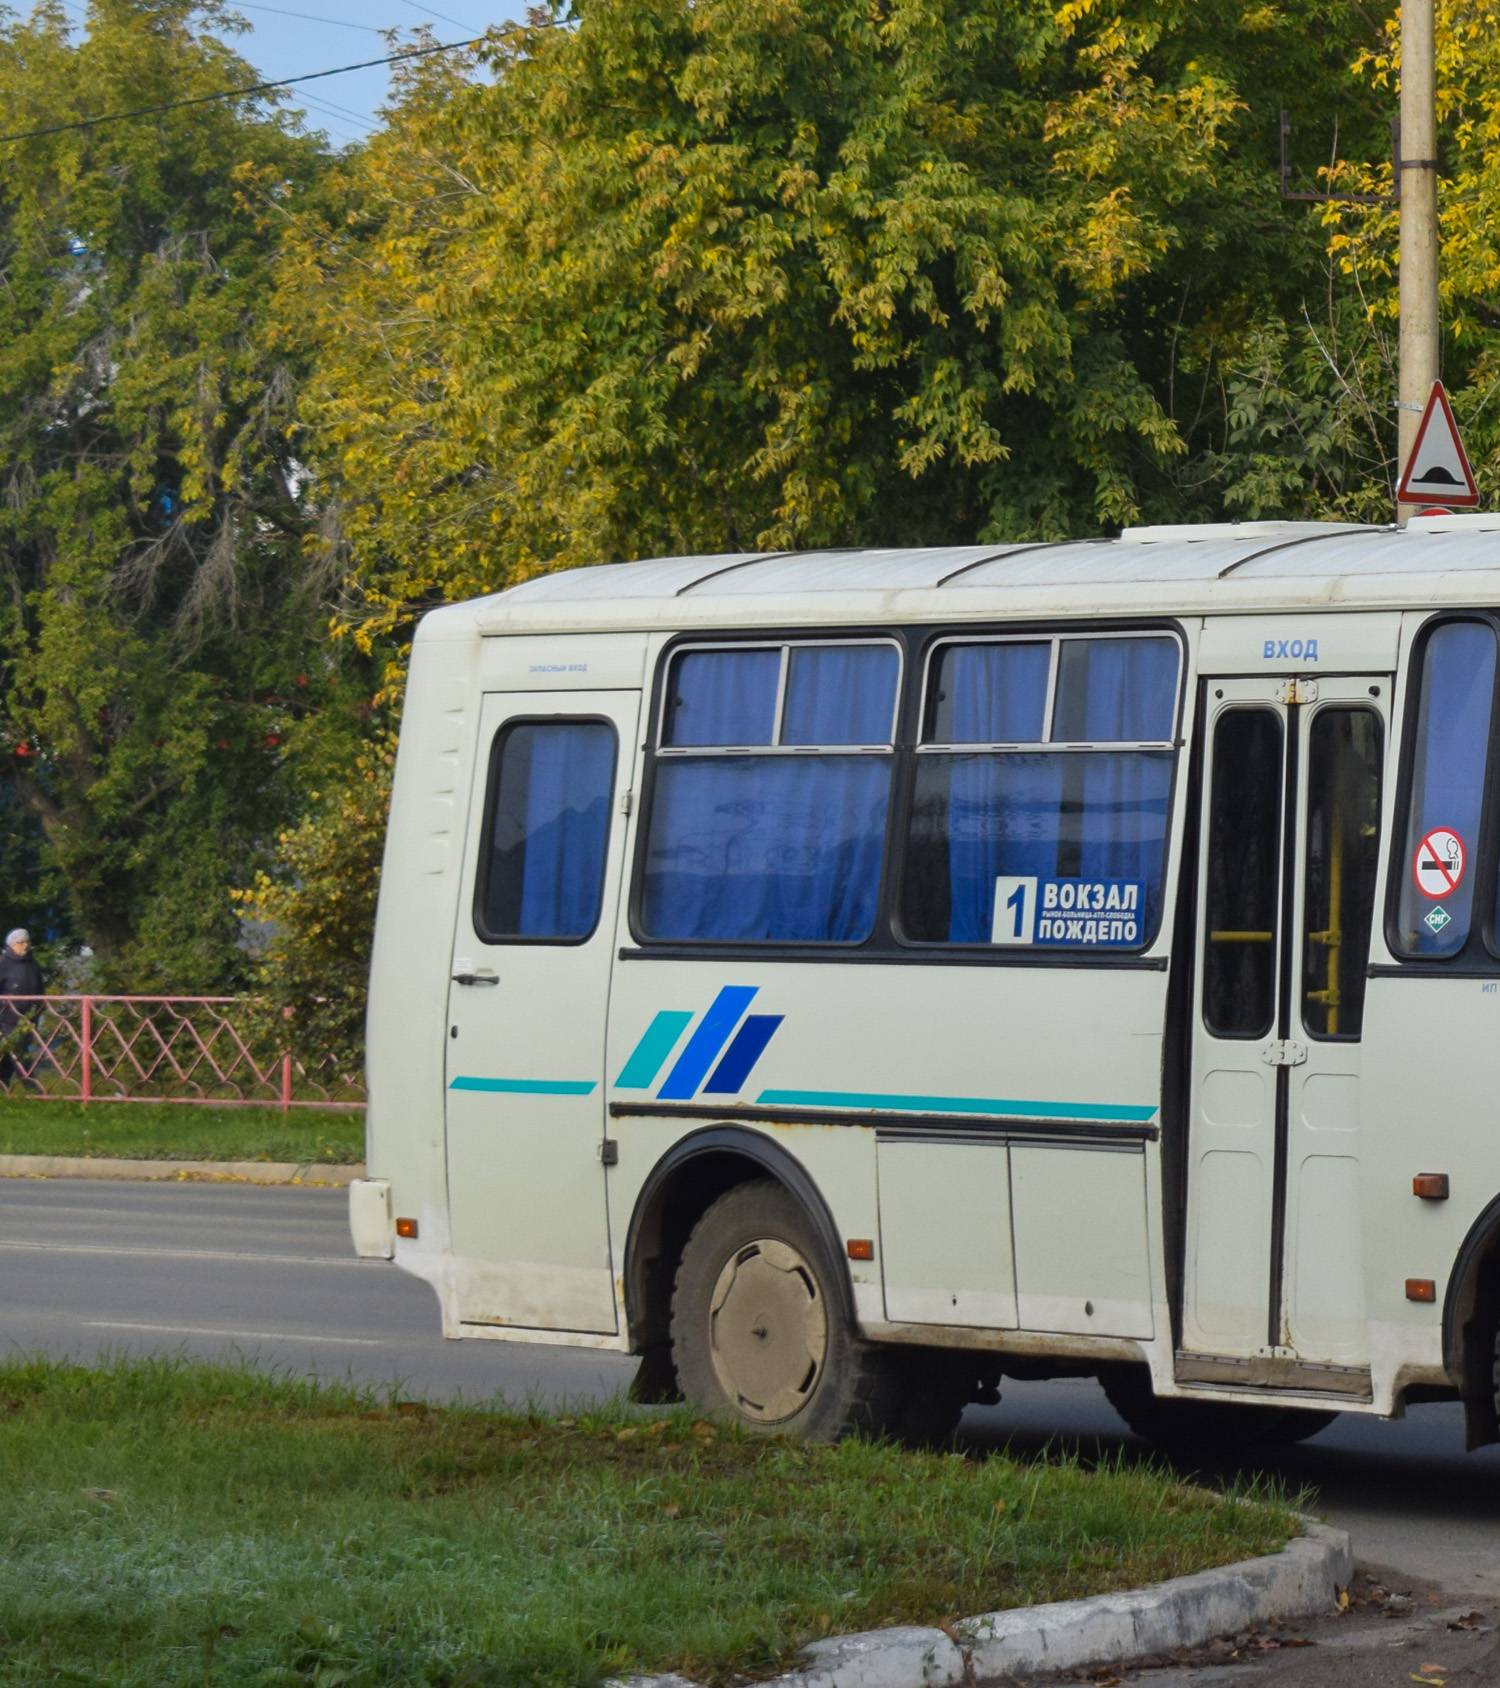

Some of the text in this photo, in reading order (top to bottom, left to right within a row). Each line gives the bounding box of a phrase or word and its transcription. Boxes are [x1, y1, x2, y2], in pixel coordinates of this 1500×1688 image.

[1263, 639, 1318, 661] ВХОД
[1043, 883, 1138, 911] ВОКЗАЛ
[1007, 884, 1026, 938] 1
[1038, 919, 1137, 943] ПОЖДЕПО
[1482, 983, 1497, 993] ИП
